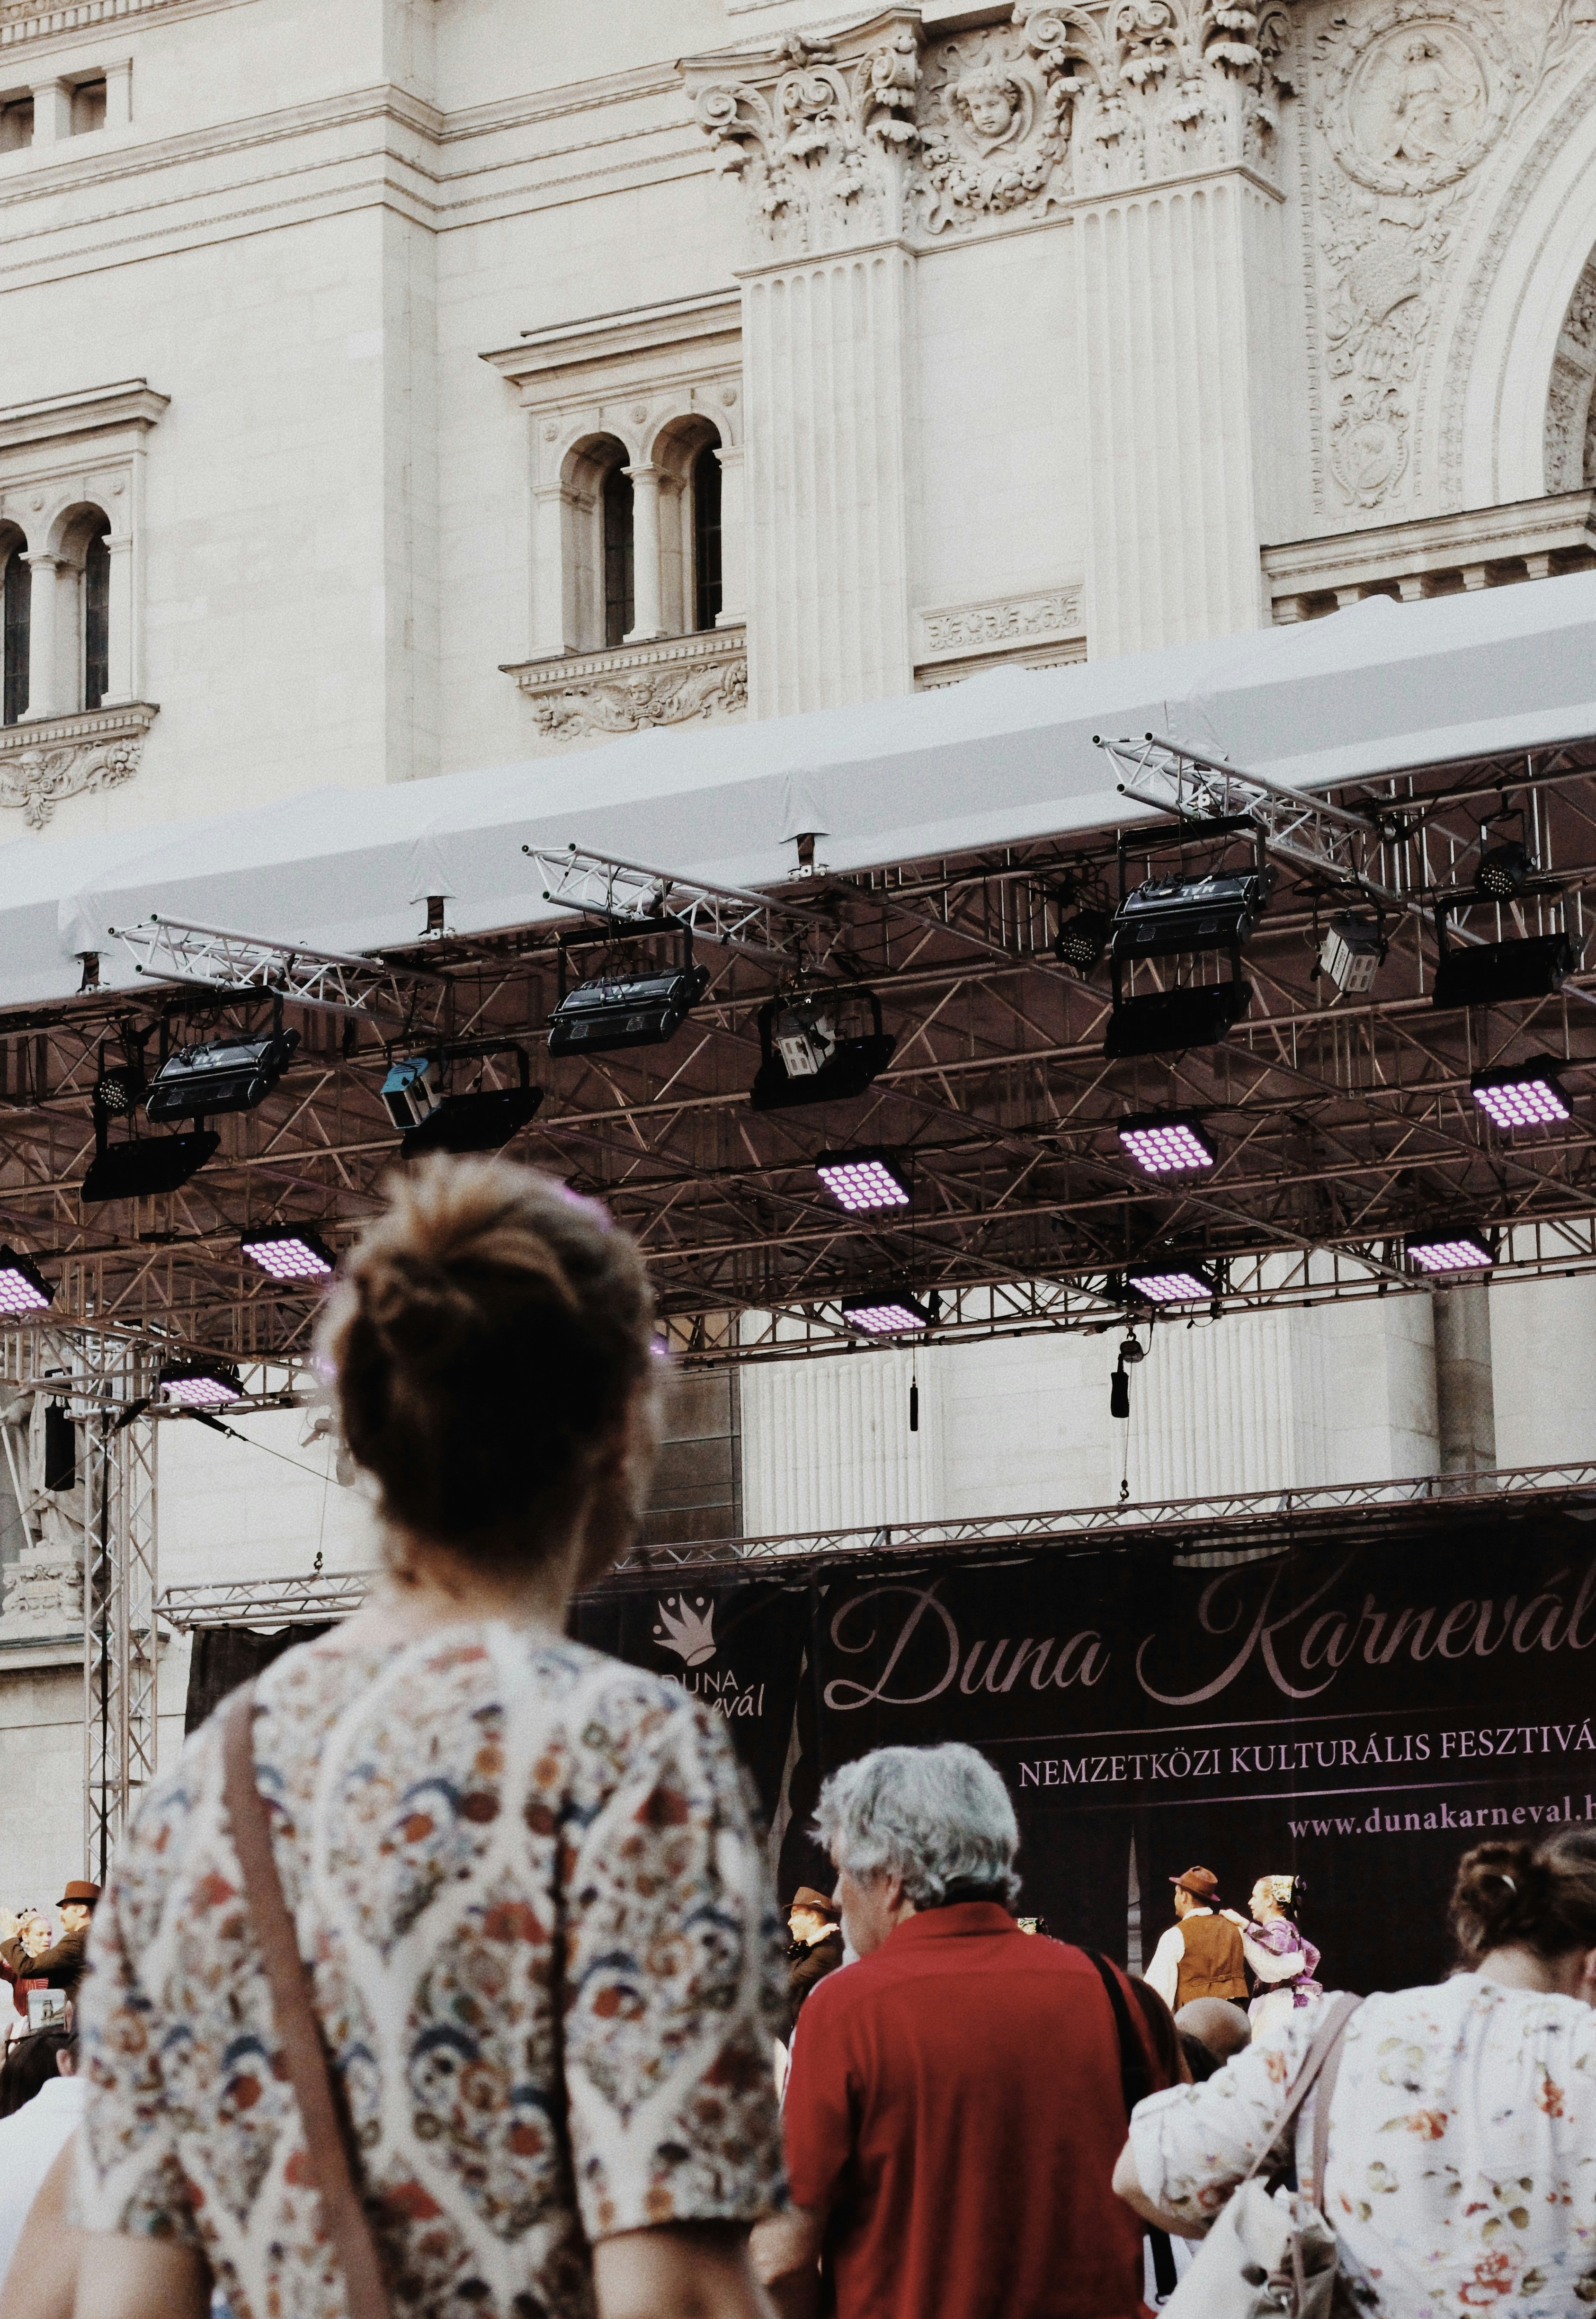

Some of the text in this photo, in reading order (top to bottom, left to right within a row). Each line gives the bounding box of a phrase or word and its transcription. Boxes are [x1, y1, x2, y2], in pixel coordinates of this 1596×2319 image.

[823, 1549, 1596, 1710] Duna Karnevál
[1019, 1746, 1221, 1787] NEMZETKÖZI
[1230, 1730, 1430, 1773] KULTURÁLIS
